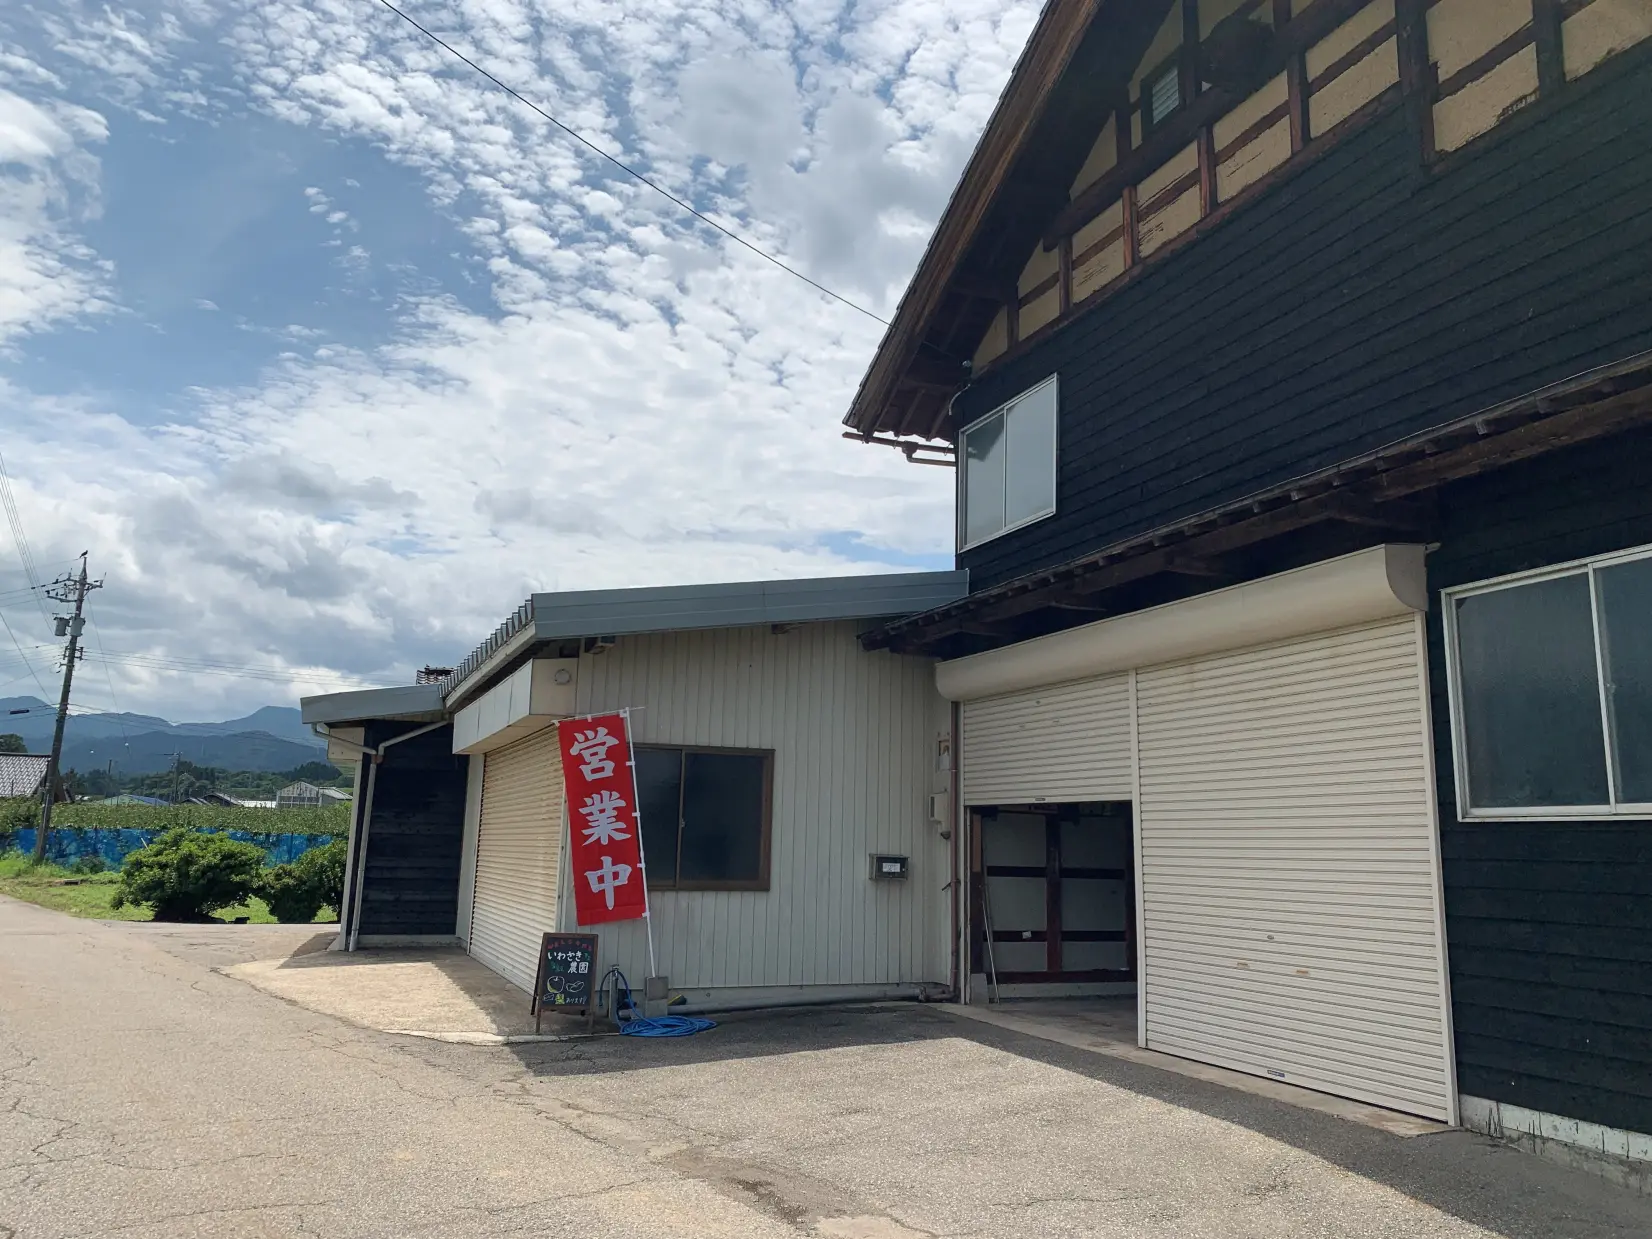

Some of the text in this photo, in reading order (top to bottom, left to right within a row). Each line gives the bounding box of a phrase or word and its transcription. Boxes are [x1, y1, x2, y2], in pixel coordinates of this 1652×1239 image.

[570, 726, 632, 911] 営業中
[548, 951, 582, 961] いわさき
[568, 961, 588, 973] 農園
